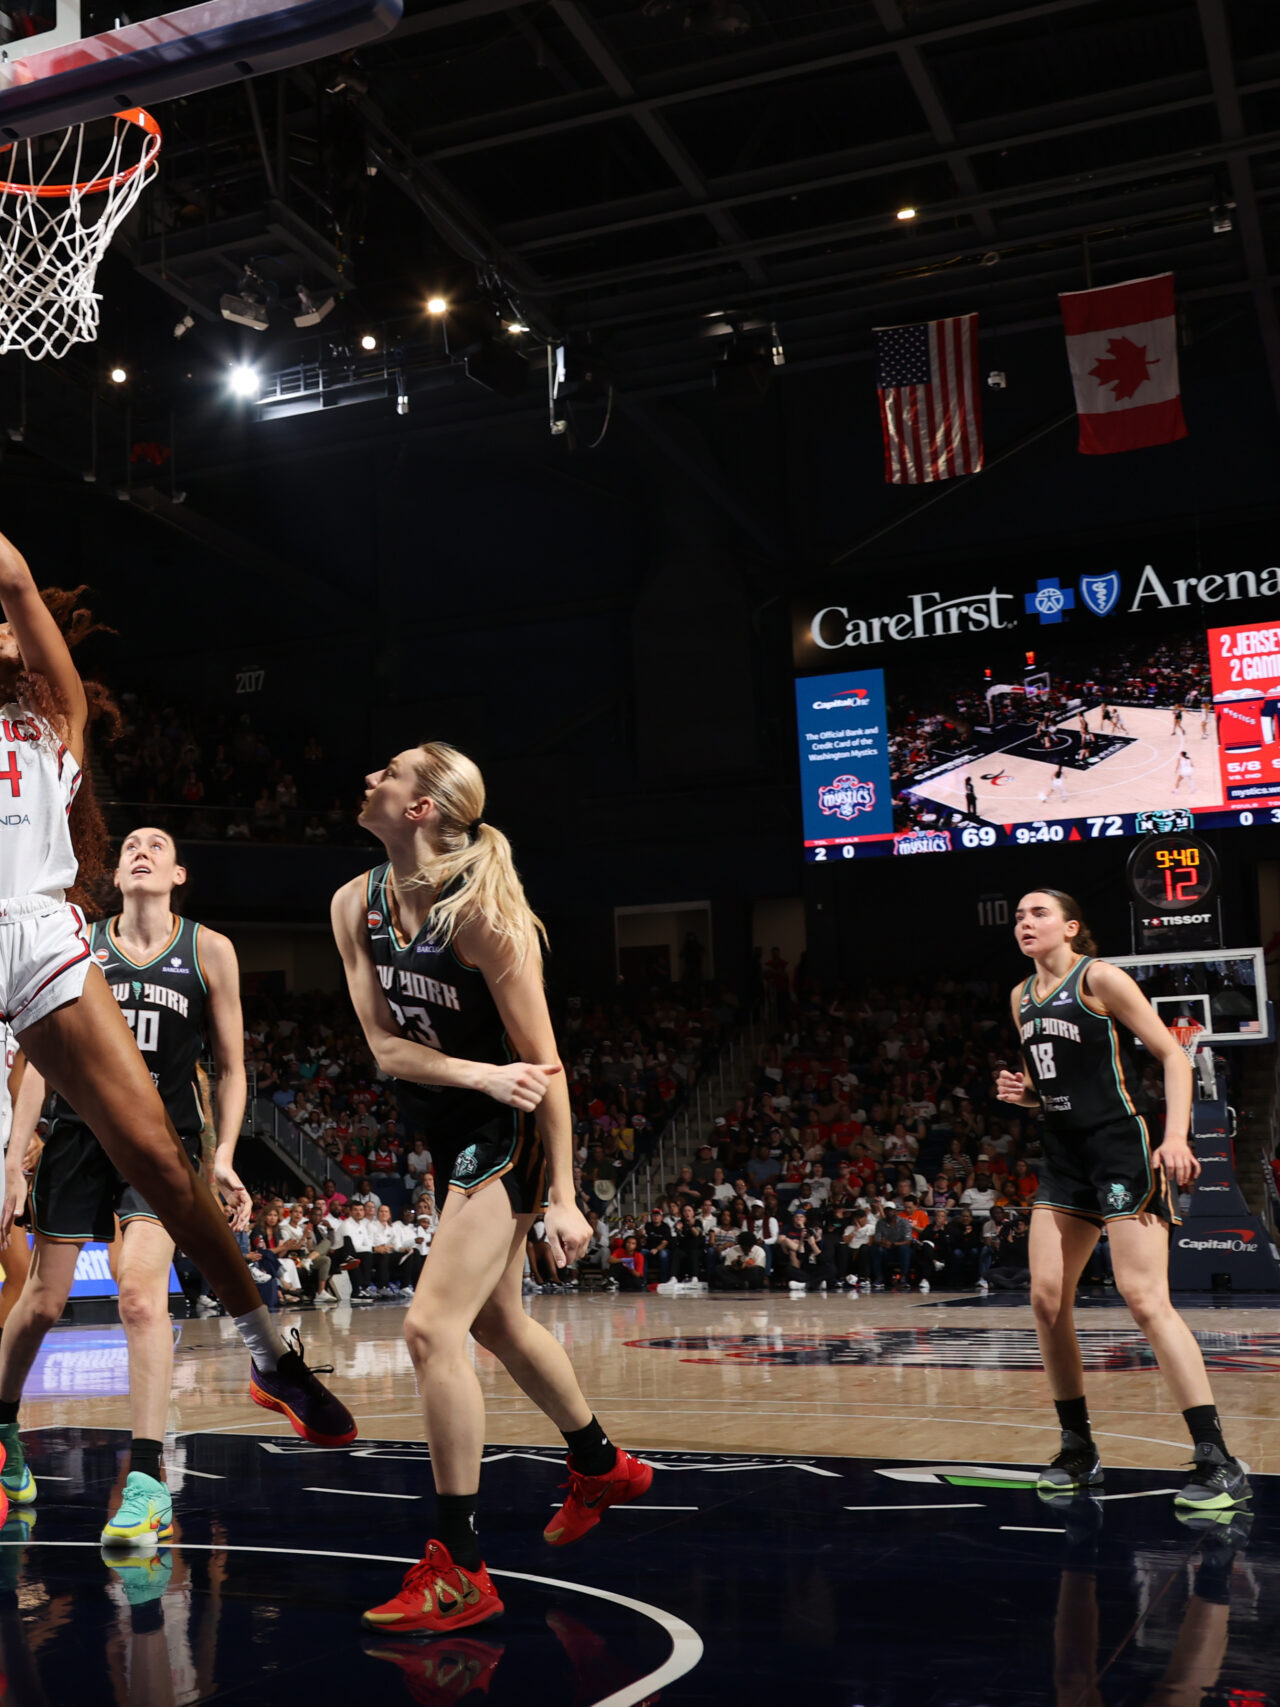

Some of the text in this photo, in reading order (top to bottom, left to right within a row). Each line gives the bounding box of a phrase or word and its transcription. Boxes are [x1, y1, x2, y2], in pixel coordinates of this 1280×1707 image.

[810, 564, 1280, 650] CareFirst Arena
[1220, 628, 1280, 657] 2 JERSE
[235, 669, 265, 694] 207
[1230, 659, 1242, 682] 2
[805, 726, 879, 741] The Official Bank and
[812, 738, 874, 751] Credit Card of the
[808, 748, 878, 761] Washington Mystics
[1087, 816, 1124, 838] 72
[1239, 811, 1254, 826] 0
[962, 827, 997, 847] 69
[1016, 825, 1064, 844] 9:40
[814, 845, 854, 861] 2 0
[1155, 848, 1200, 868] 9:40
[1164, 867, 1200, 901] 12
[977, 900, 1010, 927] 110
[1160, 913, 1212, 926] TISSOT
[143, 982, 190, 1019] YORK
[398, 970, 462, 1012] YORK
[1041, 1017, 1082, 1044] YORK
[1029, 1041, 1057, 1080] 18
